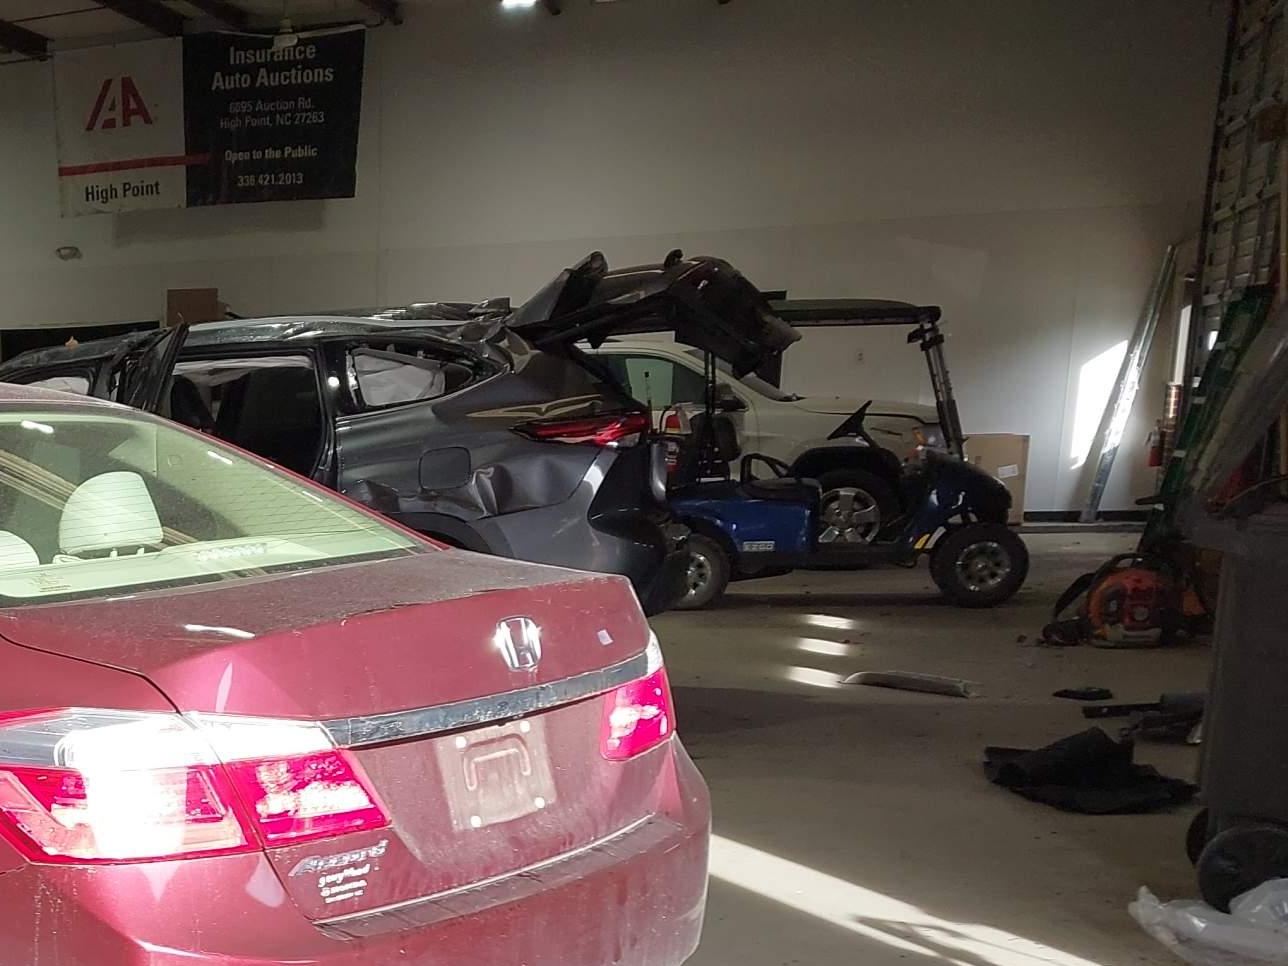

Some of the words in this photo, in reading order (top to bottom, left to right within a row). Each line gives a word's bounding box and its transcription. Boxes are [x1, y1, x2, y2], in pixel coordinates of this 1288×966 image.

[229, 44, 317, 64] Insurance
[211, 71, 251, 91] Auto
[255, 65, 335, 87] Auctions
[255, 98, 295, 112] Auction
[297, 97, 314, 110] Rd.
[219, 117, 242, 131] High
[276, 113, 292, 126] NC
[224, 149, 250, 165] Open
[252, 149, 262, 161] to
[264, 147, 282, 160] the
[284, 144, 319, 159] Public
[85, 184, 118, 204] High
[123, 180, 160, 198] Point
